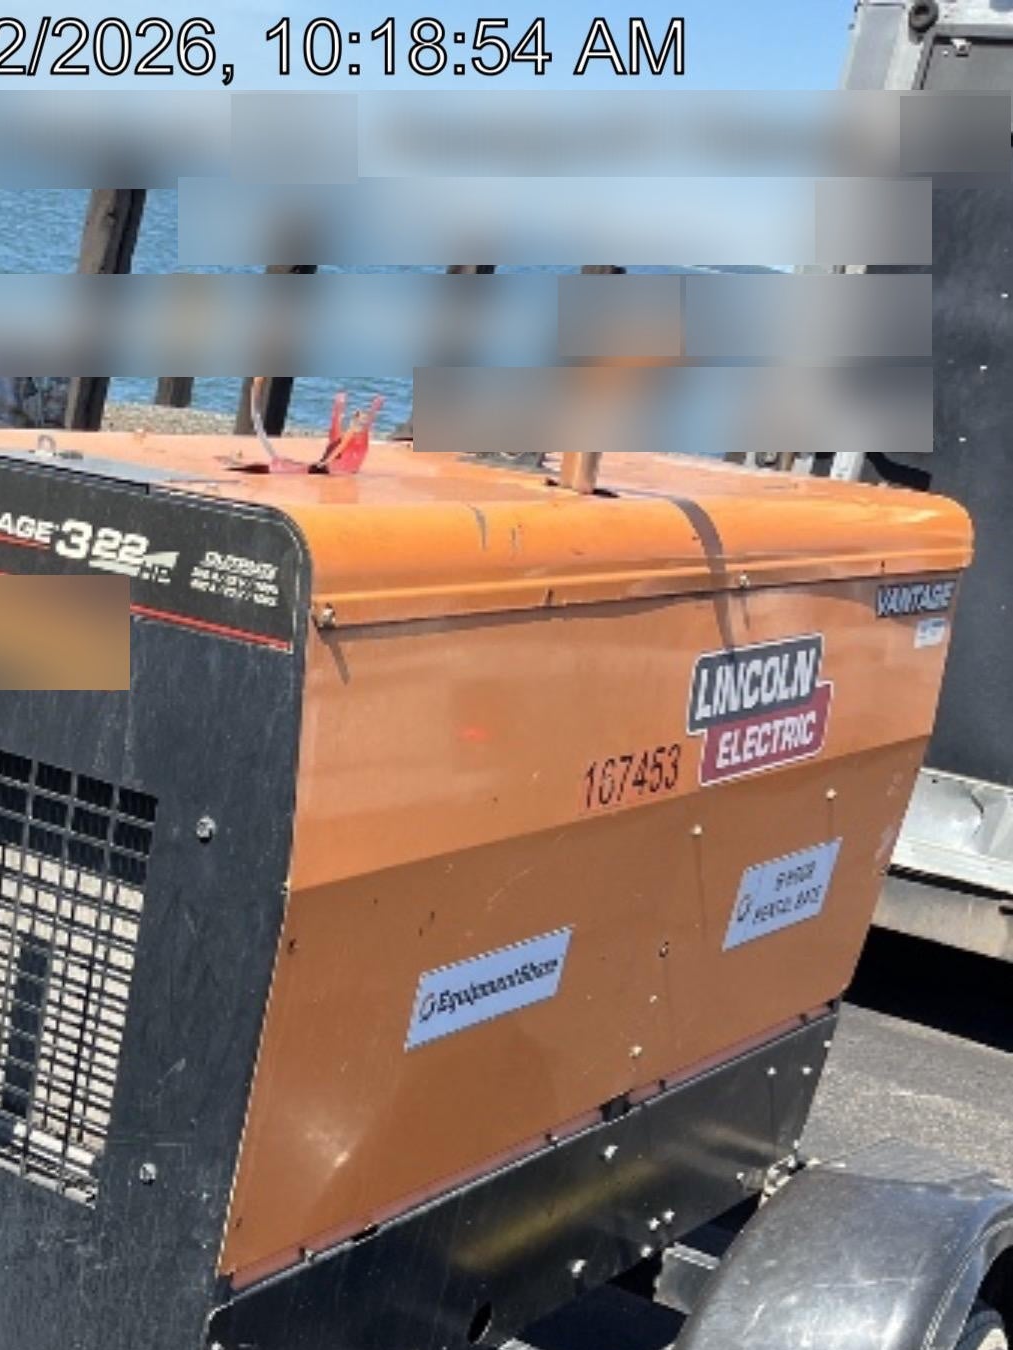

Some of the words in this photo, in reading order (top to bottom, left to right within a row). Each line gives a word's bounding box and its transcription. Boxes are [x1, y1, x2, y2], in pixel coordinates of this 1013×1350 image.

[55, 518, 149, 566] 322
[877, 581, 956, 616] VANTAGE
[694, 648, 817, 721] LINCOLN
[715, 711, 817, 769] ELECTRIC
[586, 743, 681, 809] 167453
